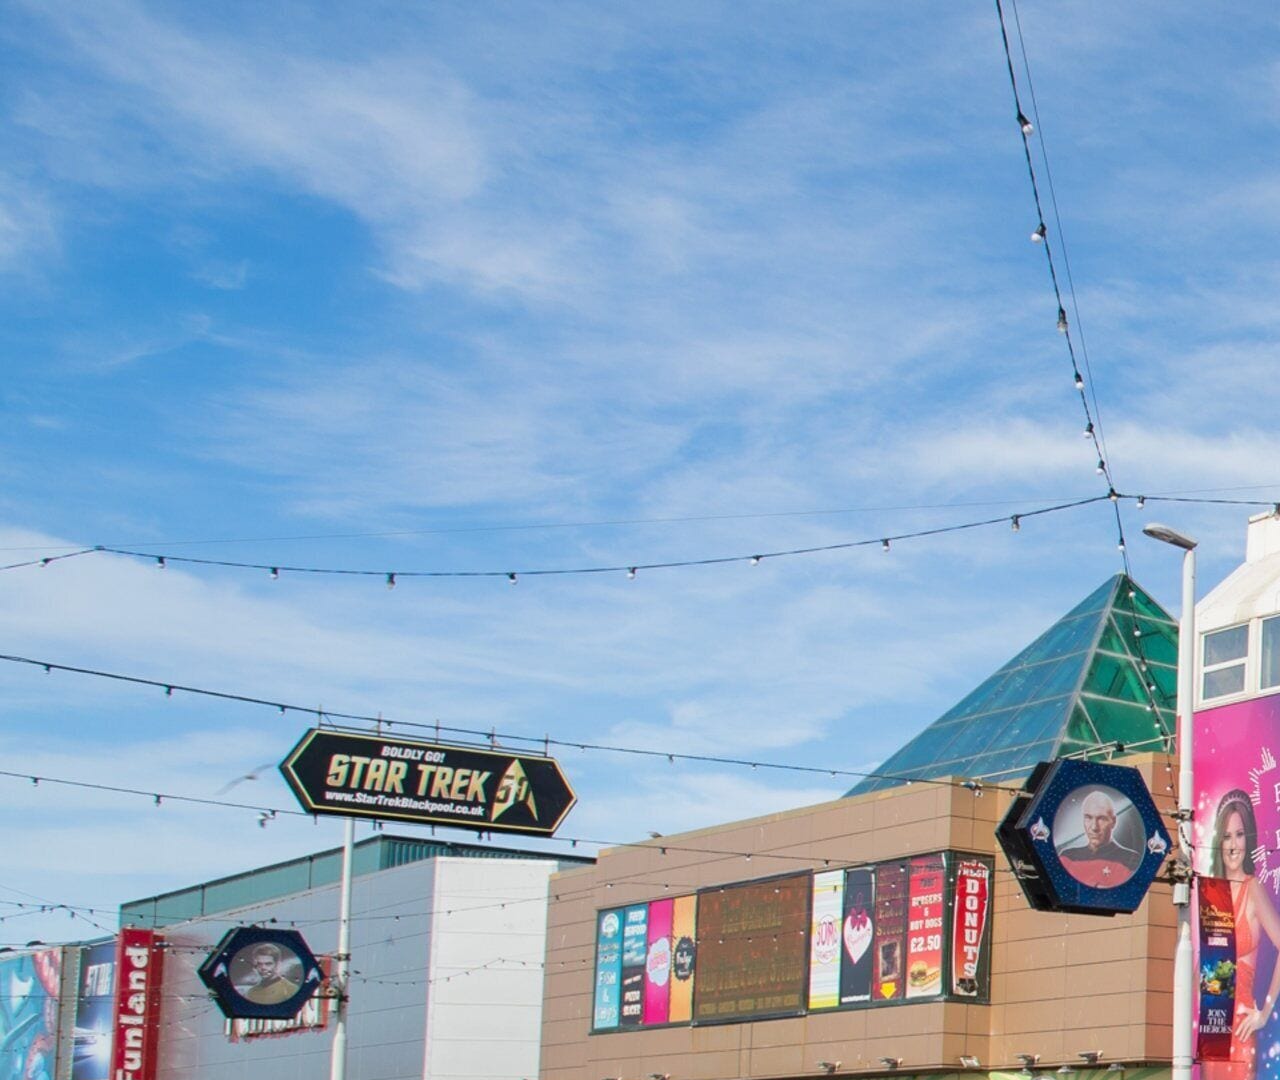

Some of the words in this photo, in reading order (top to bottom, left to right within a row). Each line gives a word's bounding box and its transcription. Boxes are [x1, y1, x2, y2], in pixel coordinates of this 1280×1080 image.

[381, 745, 424, 762] BOLDLY
[424, 750, 446, 763] GO!
[325, 753, 408, 794] STAR
[416, 763, 492, 803] TREK
[324, 791, 486, 816] www.StarTrekBlackpool.co.uk
[910, 919, 925, 931] HOT
[925, 918, 943, 929] DOGS
[963, 878, 980, 977] DONUTS
[910, 934, 941, 953] £2.50
[1207, 1009, 1227, 1018] JOIN
[1207, 1017, 1226, 1026] THE
[1199, 1024, 1233, 1034] HEROES
